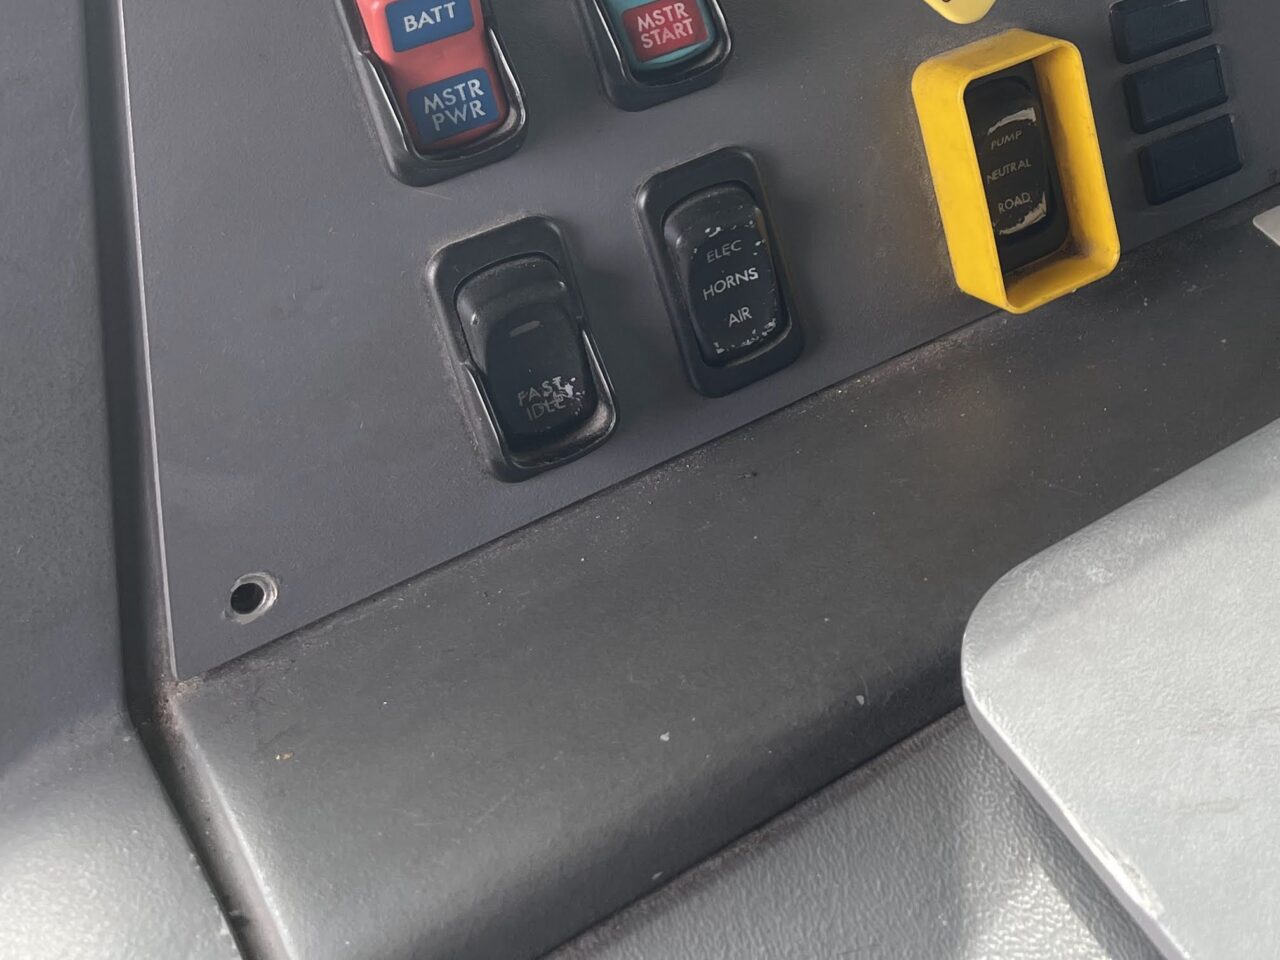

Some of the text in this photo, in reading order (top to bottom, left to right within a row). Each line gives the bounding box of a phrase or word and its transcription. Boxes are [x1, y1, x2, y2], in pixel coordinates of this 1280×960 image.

[403, 0, 457, 33] BATT
[636, 1, 691, 32] MSTR
[639, 18, 697, 50] START
[423, 79, 485, 114] MSTR
[431, 101, 487, 132] PWR
[991, 129, 1022, 149] PUMP
[987, 158, 1032, 184] NEUTRAL
[998, 192, 1031, 213] ROAD
[706, 239, 742, 264] ELEC
[702, 267, 759, 301] HORNS
[728, 306, 752, 328] AIR
[518, 376, 562, 406] FAST
